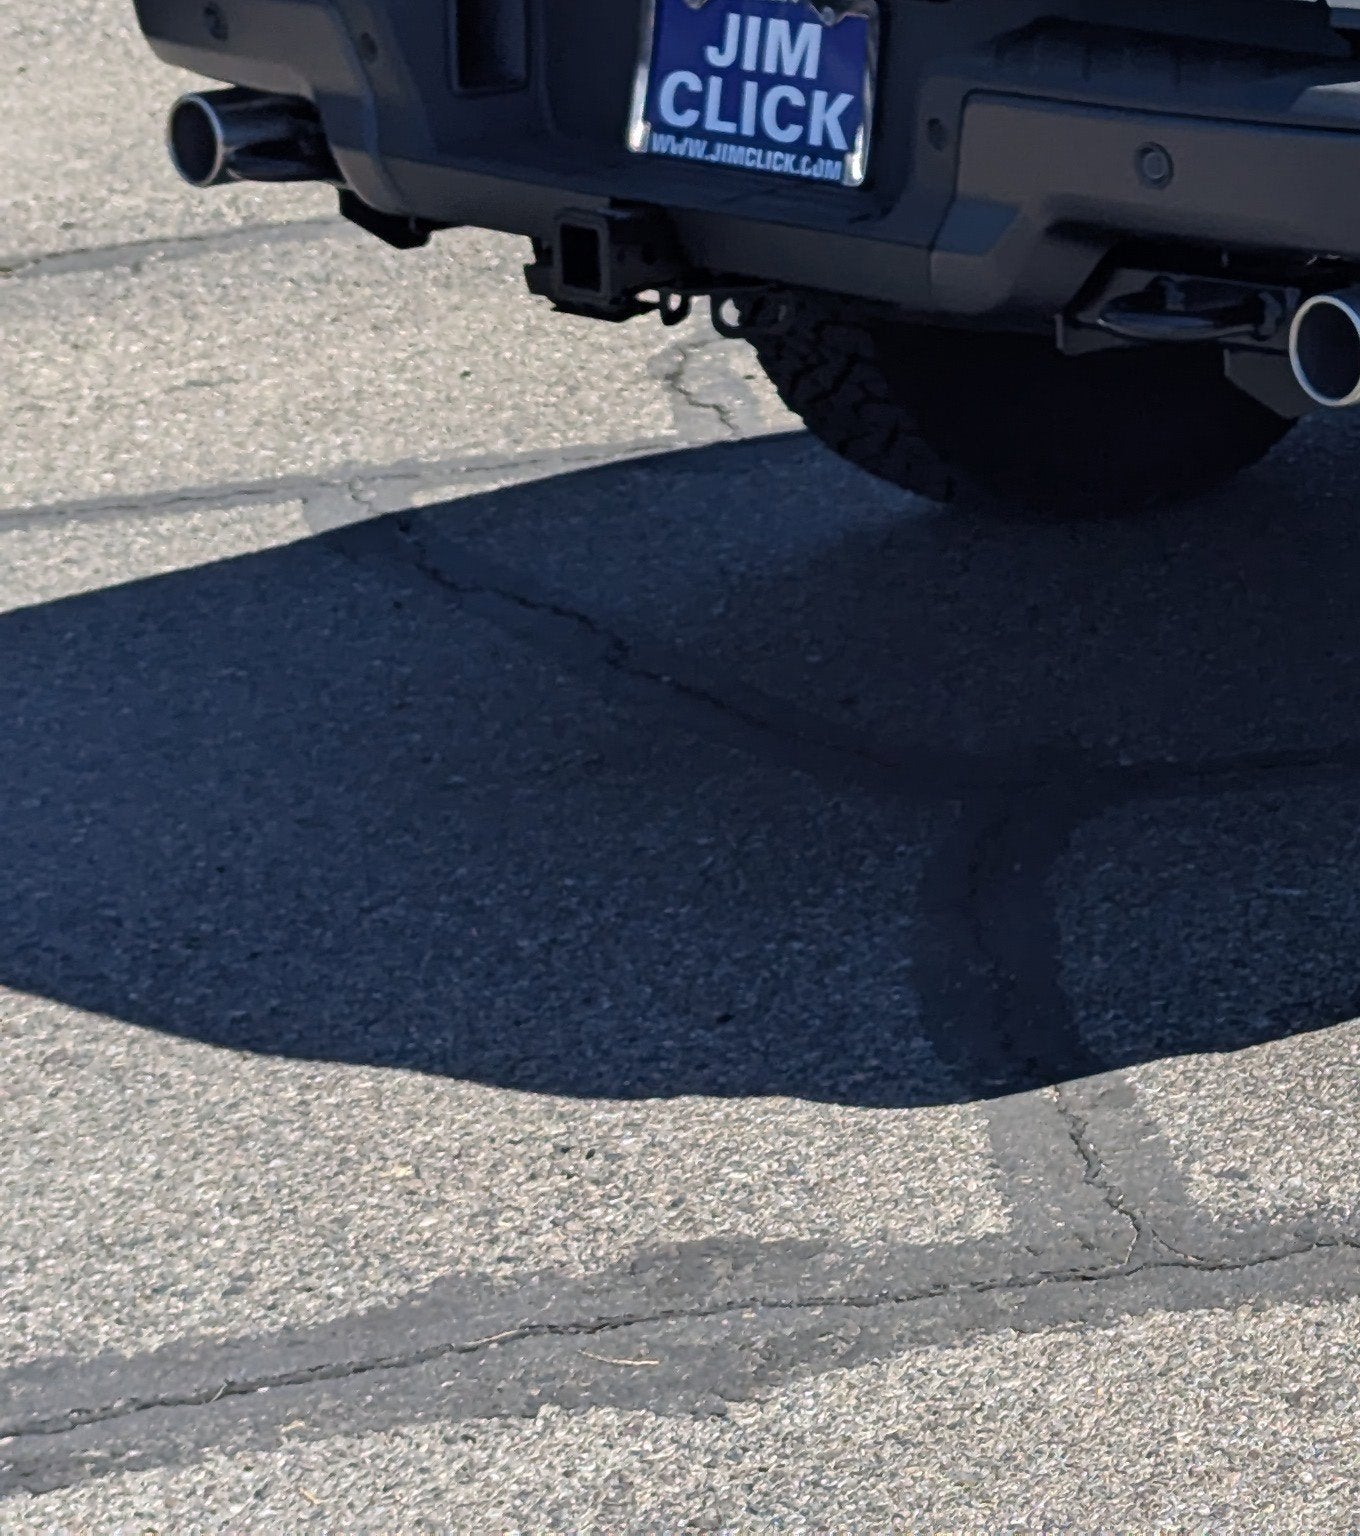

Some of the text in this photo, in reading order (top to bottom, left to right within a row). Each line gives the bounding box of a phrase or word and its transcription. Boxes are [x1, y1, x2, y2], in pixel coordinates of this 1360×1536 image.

[705, 12, 823, 80] JIM
[658, 70, 855, 151] CLICK
[652, 131, 844, 181] WWW.JIMCLICK.COM
